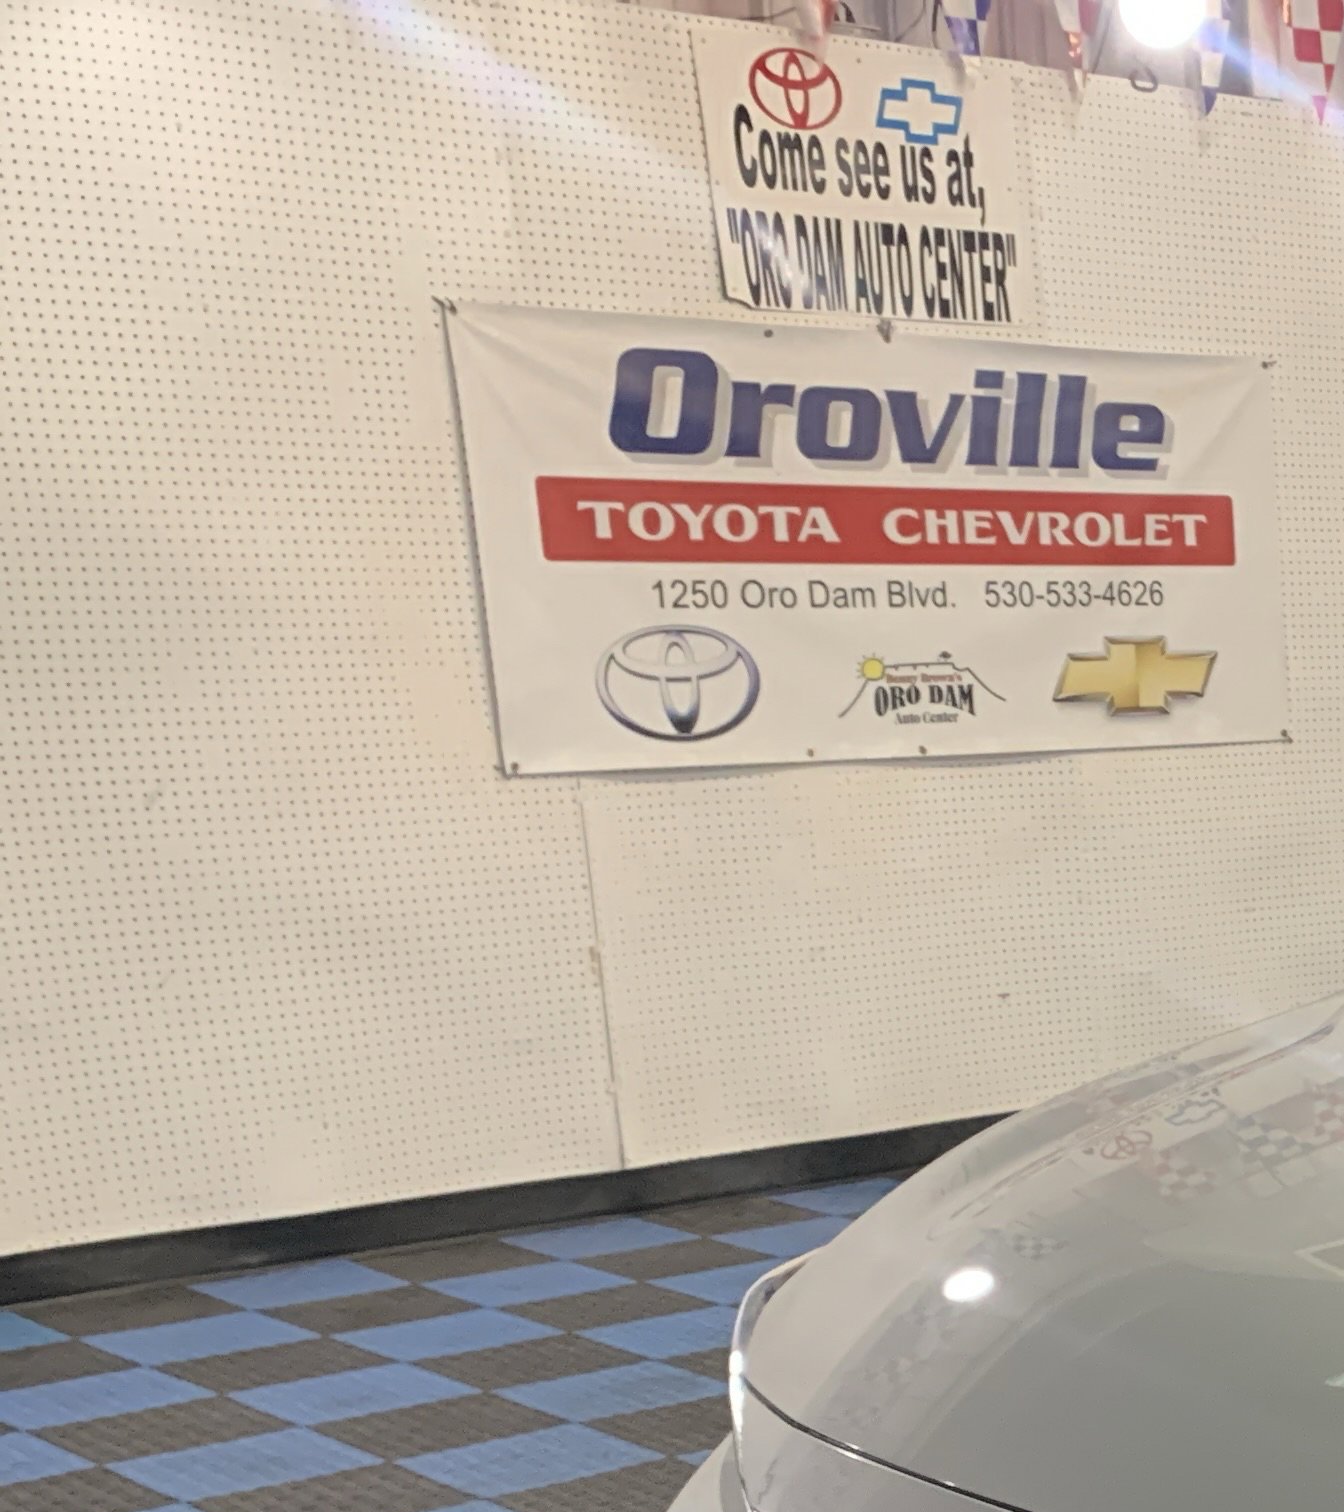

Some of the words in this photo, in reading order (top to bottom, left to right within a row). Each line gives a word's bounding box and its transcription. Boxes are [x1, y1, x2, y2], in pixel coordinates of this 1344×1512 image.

[734, 103, 826, 195] Come
[835, 137, 890, 200] see
[900, 144, 936, 204] us
[946, 132, 986, 227] at,
[794, 214, 848, 312] DAM
[854, 219, 914, 317] AUTO
[609, 347, 1166, 472] Oroville
[577, 501, 841, 544] TOYOTA
[882, 507, 1208, 547] CHEVROLET
[650, 580, 728, 609] 1250
[740, 580, 797, 609] Oro
[808, 580, 876, 609] Dam
[887, 580, 957, 609] Blvd.
[985, 580, 1165, 609] 530-533-4626
[874, 685, 921, 717] ORO
[928, 684, 977, 716] DAM
[894, 713, 921, 725] Auto
[923, 712, 959, 724] Center
